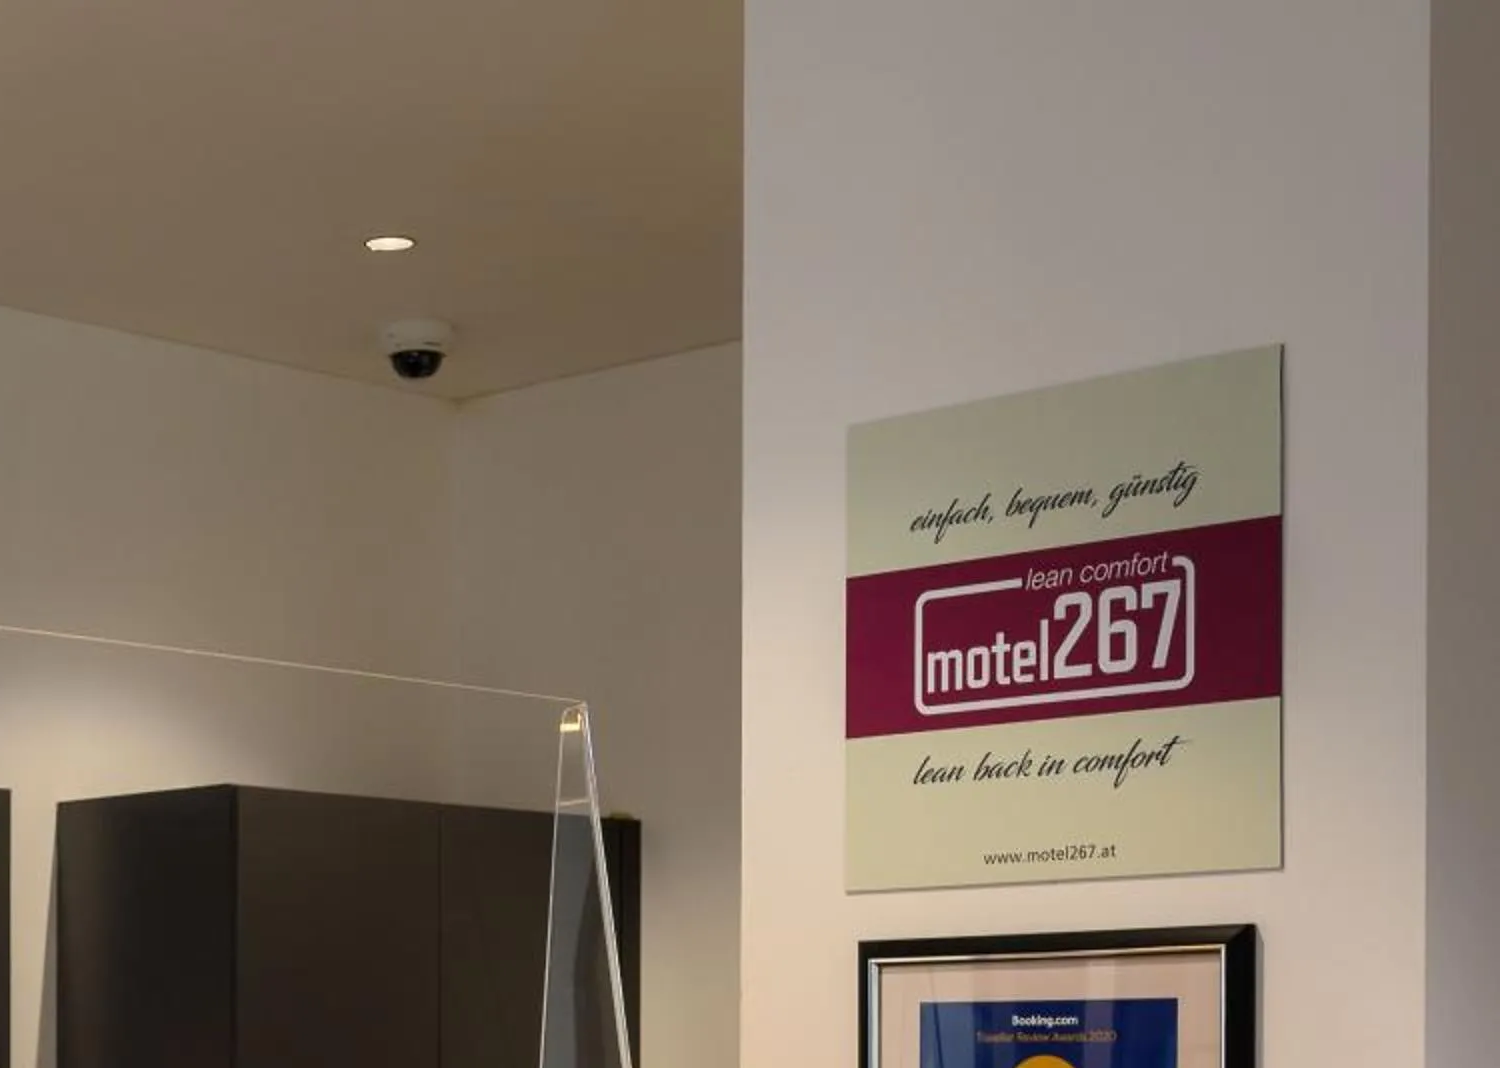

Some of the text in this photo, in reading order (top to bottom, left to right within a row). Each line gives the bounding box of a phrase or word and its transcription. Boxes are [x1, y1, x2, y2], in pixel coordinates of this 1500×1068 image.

[909, 460, 1201, 544] einfach, bequem, günstig
[1025, 551, 1169, 591] lean comfort
[926, 578, 1182, 694] motel267
[912, 735, 1193, 789] lean back in comfort
[983, 843, 1117, 866] www.motel267.at
[1011, 1015, 1079, 1028] Booking.com
